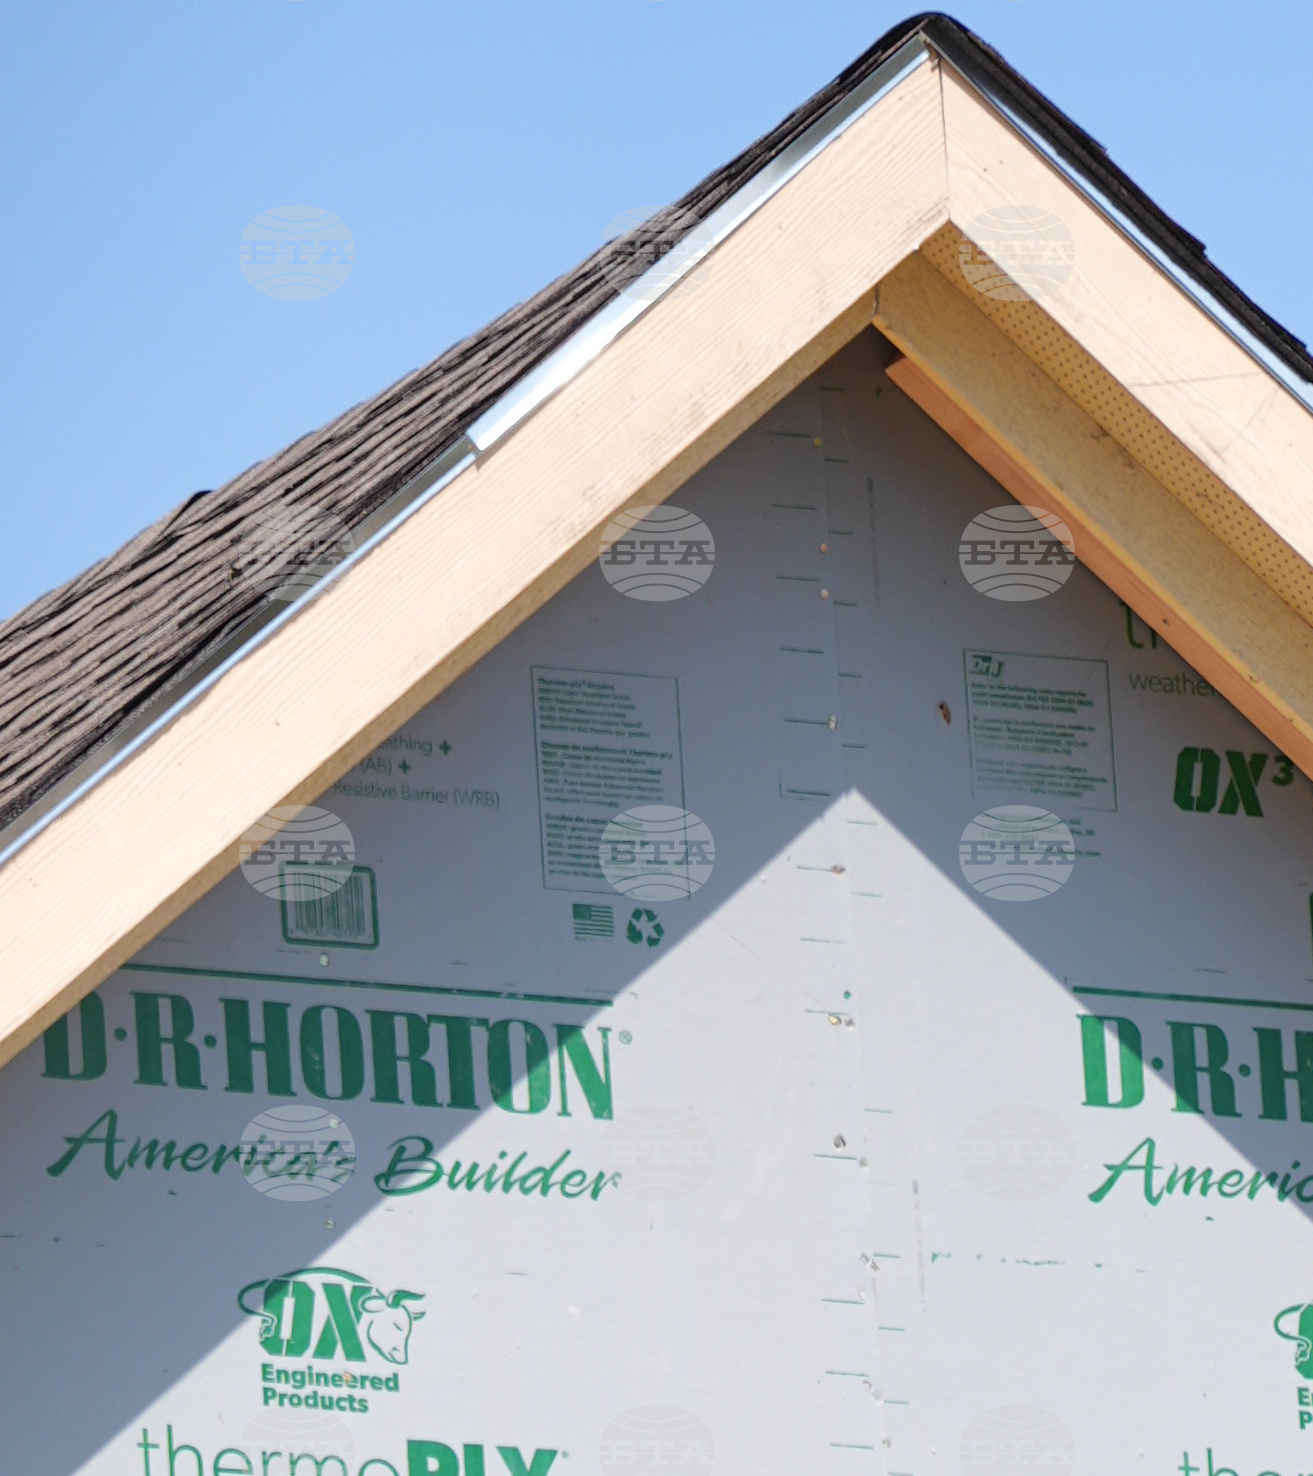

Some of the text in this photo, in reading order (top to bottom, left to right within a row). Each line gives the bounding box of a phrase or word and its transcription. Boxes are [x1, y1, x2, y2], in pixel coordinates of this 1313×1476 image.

[47, 1108, 621, 1201] America's Builder
[249, 1270, 376, 1362] OX
[262, 1363, 399, 1392] Engineered
[263, 1387, 368, 1414] Products
